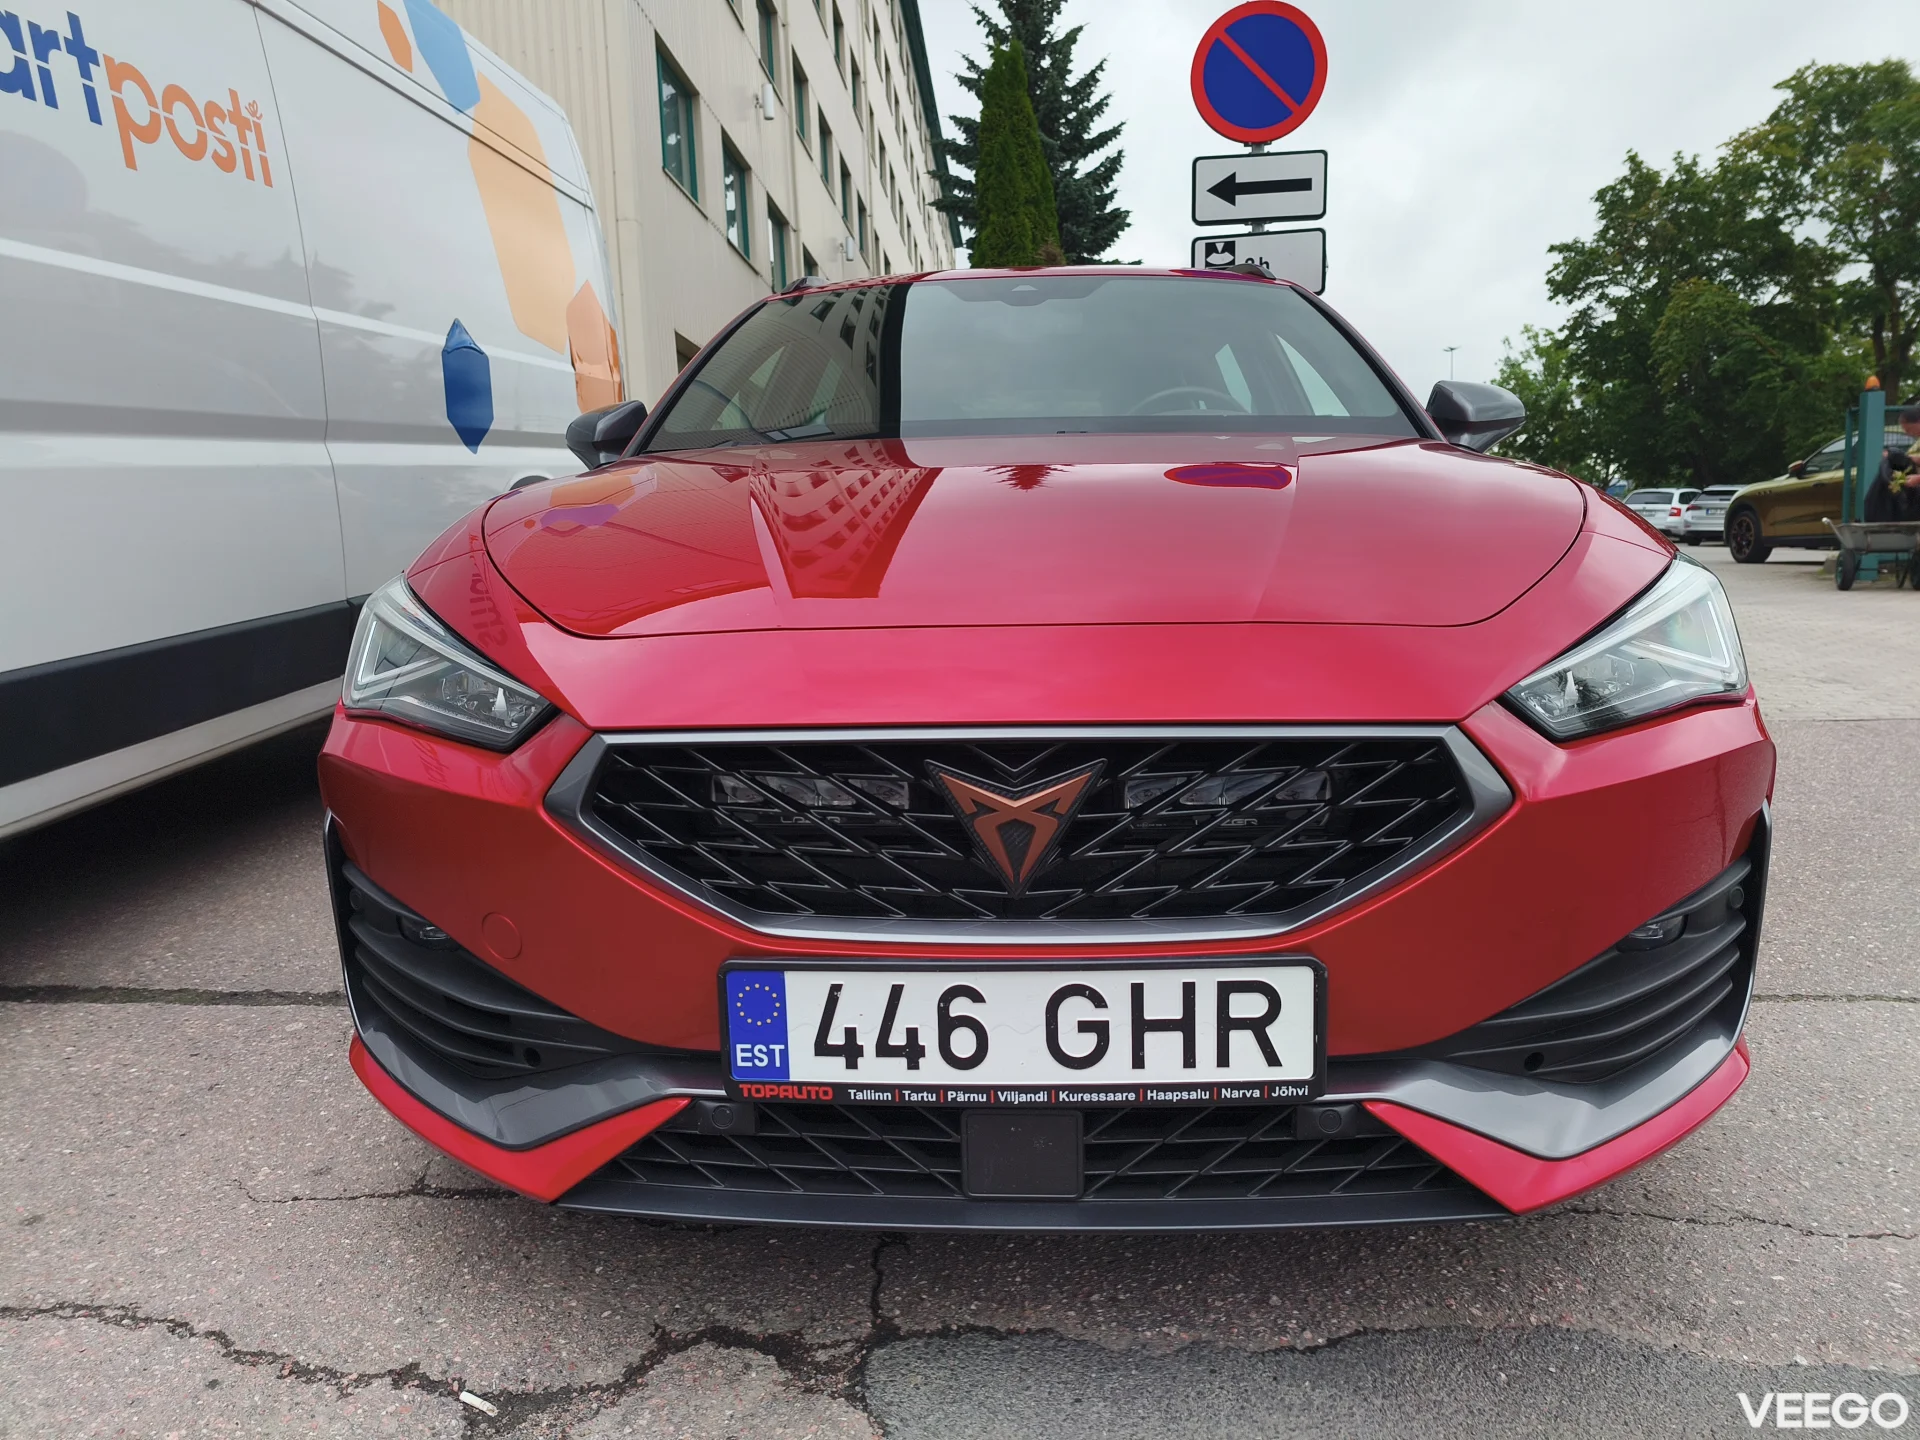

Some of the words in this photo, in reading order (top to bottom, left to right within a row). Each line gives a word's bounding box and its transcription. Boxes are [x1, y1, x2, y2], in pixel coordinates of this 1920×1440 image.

[813, 983, 989, 1071] 446
[1045, 980, 1283, 1071] GHR
[735, 1043, 785, 1068] EST
[739, 1083, 834, 1101] TOPAUTO
[848, 1089, 892, 1101] Tallinn
[902, 1090, 937, 1102] Tartu
[947, 1090, 987, 1102] Pärnu
[998, 1090, 1048, 1105] Viljandi
[1059, 1090, 1136, 1102] Kuressaare
[1147, 1088, 1210, 1103] Haapsalu
[1221, 1087, 1261, 1099] Narva
[1271, 1085, 1309, 1097] Jõhvi
